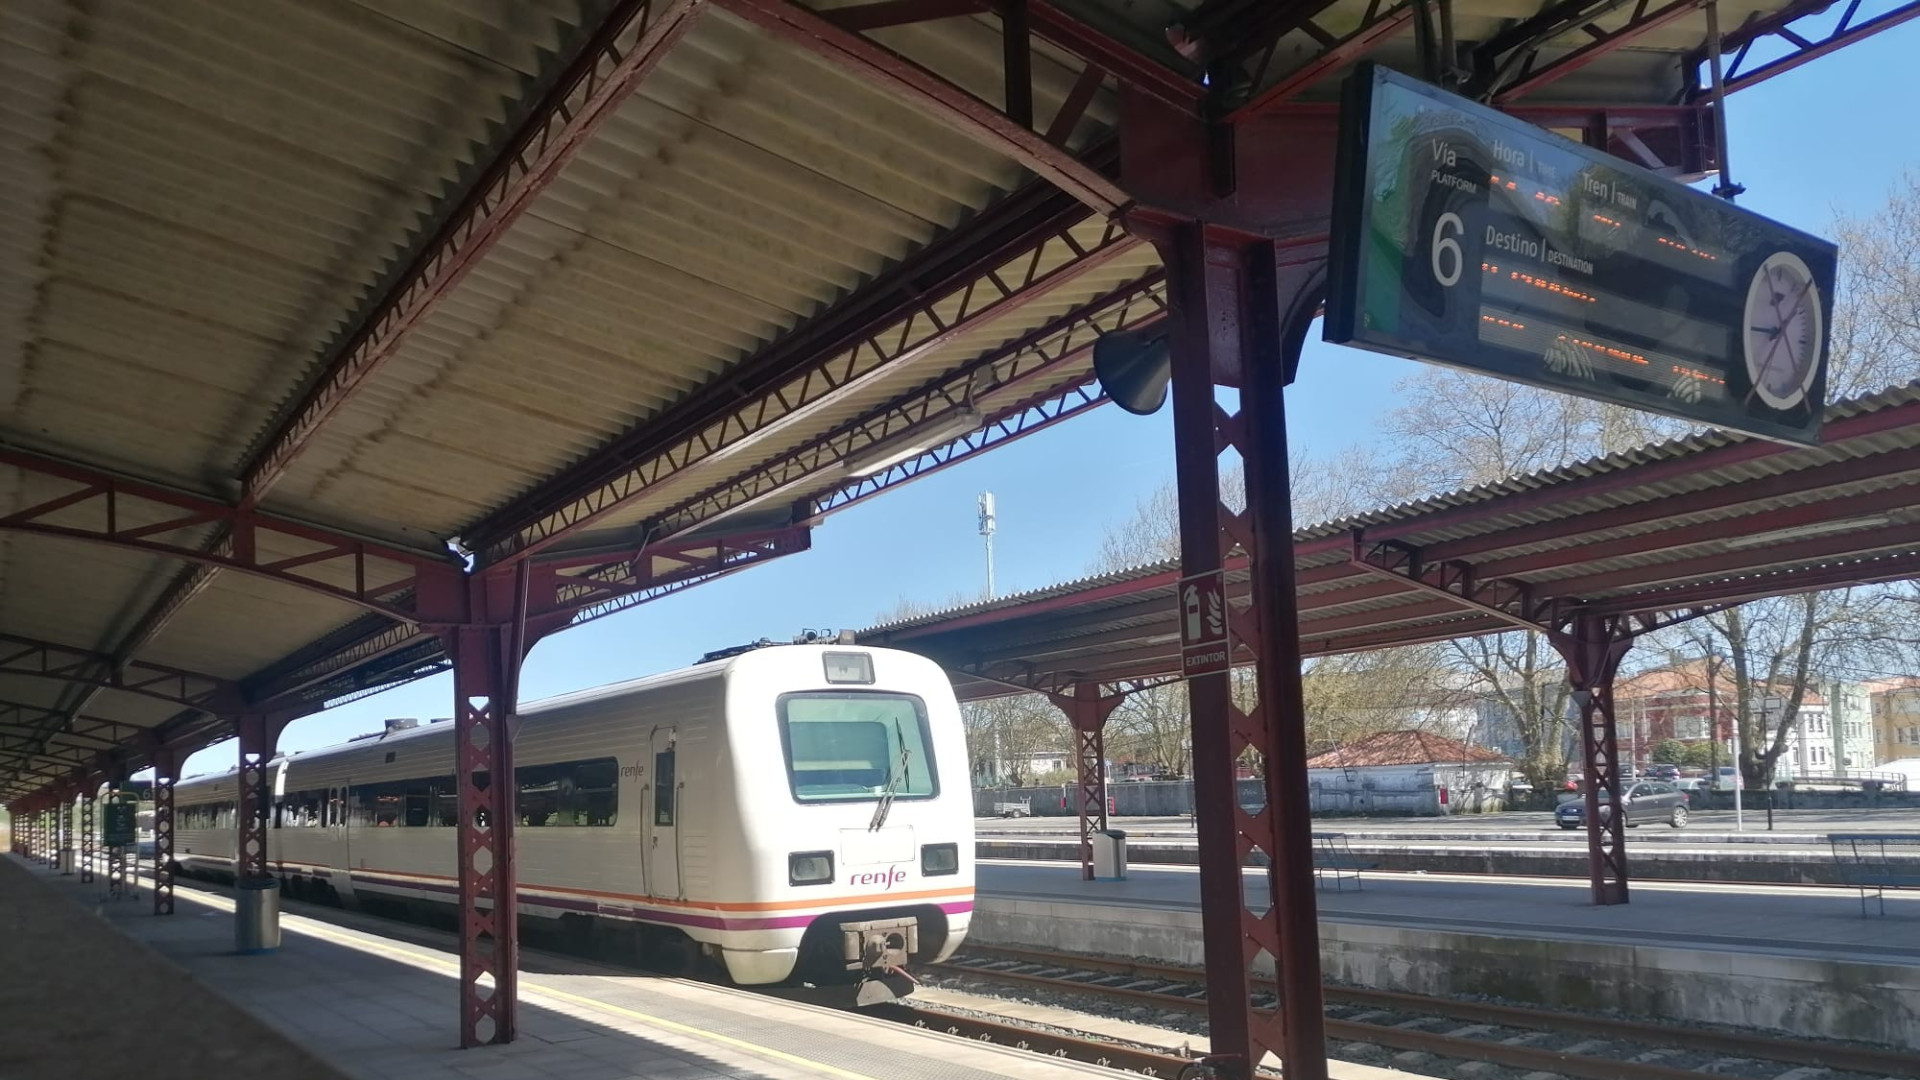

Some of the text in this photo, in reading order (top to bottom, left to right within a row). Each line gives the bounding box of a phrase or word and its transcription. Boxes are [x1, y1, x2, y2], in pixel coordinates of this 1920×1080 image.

[1493, 140, 1525, 167] Hora
[1431, 170, 1477, 194] PLATFORM
[1582, 173, 1608, 199] Tren
[1432, 212, 1464, 287] 6
[1485, 225, 1594, 275] Destino DESTINATION
[1186, 651, 1226, 667] EXTINTOR
[620, 759, 644, 783] renfe
[850, 864, 906, 891] renfe
